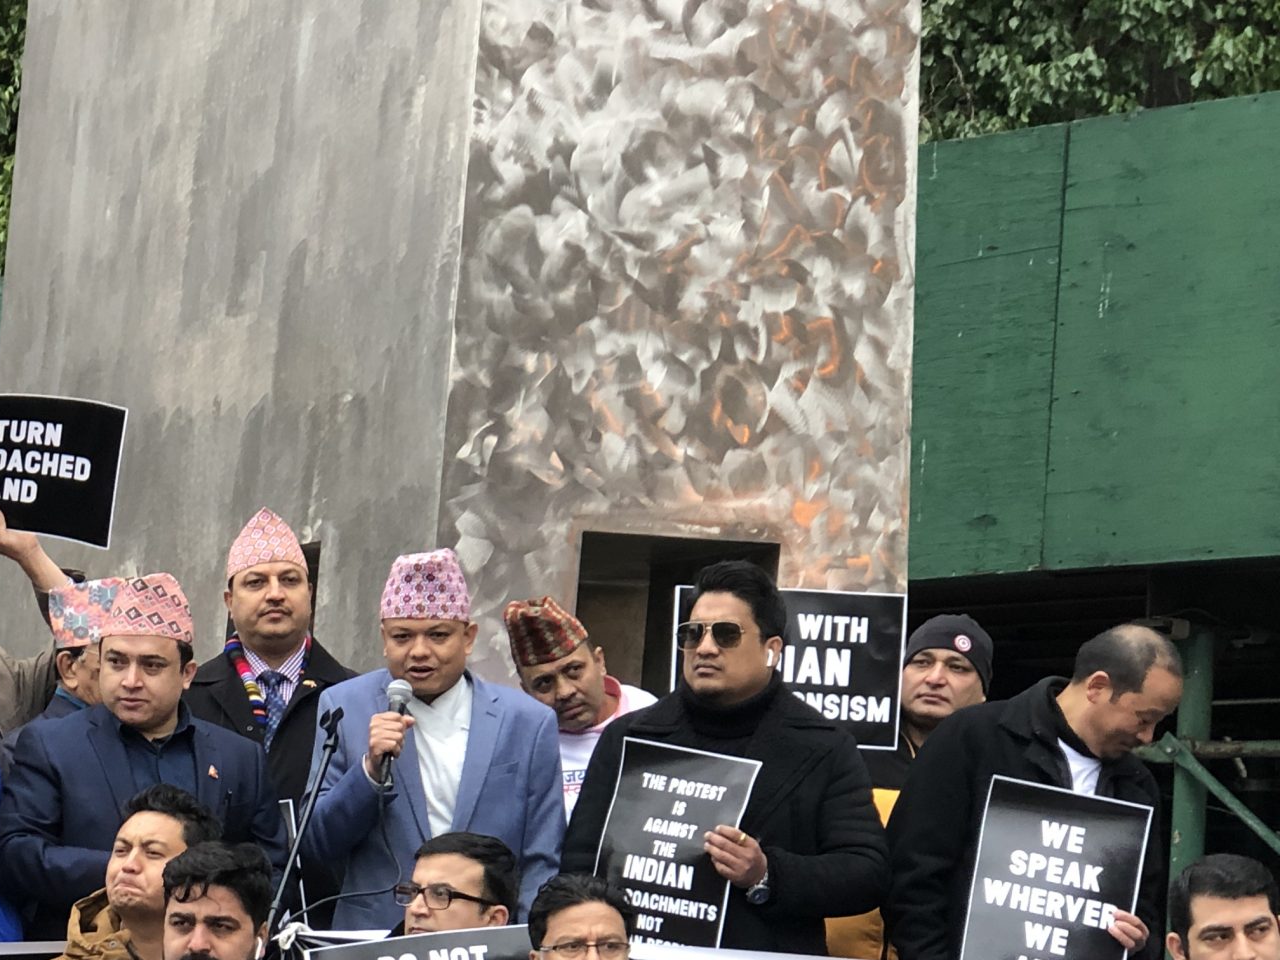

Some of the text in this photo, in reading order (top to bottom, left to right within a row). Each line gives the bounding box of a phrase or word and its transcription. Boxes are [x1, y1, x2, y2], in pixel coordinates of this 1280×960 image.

[797, 613, 869, 643] WITH
[776, 645, 851, 687] IAN
[642, 772, 727, 802] THE PROTEST
[672, 800, 687, 816] IS
[643, 817, 698, 840] AGAINST
[1041, 819, 1087, 854] WE
[652, 839, 677, 859] THE
[622, 854, 695, 891] INDIAN
[1009, 849, 1104, 893] SPEAK
[983, 877, 1118, 930] WHERVER
[636, 914, 664, 934] NOT
[1024, 921, 1069, 956] WE
